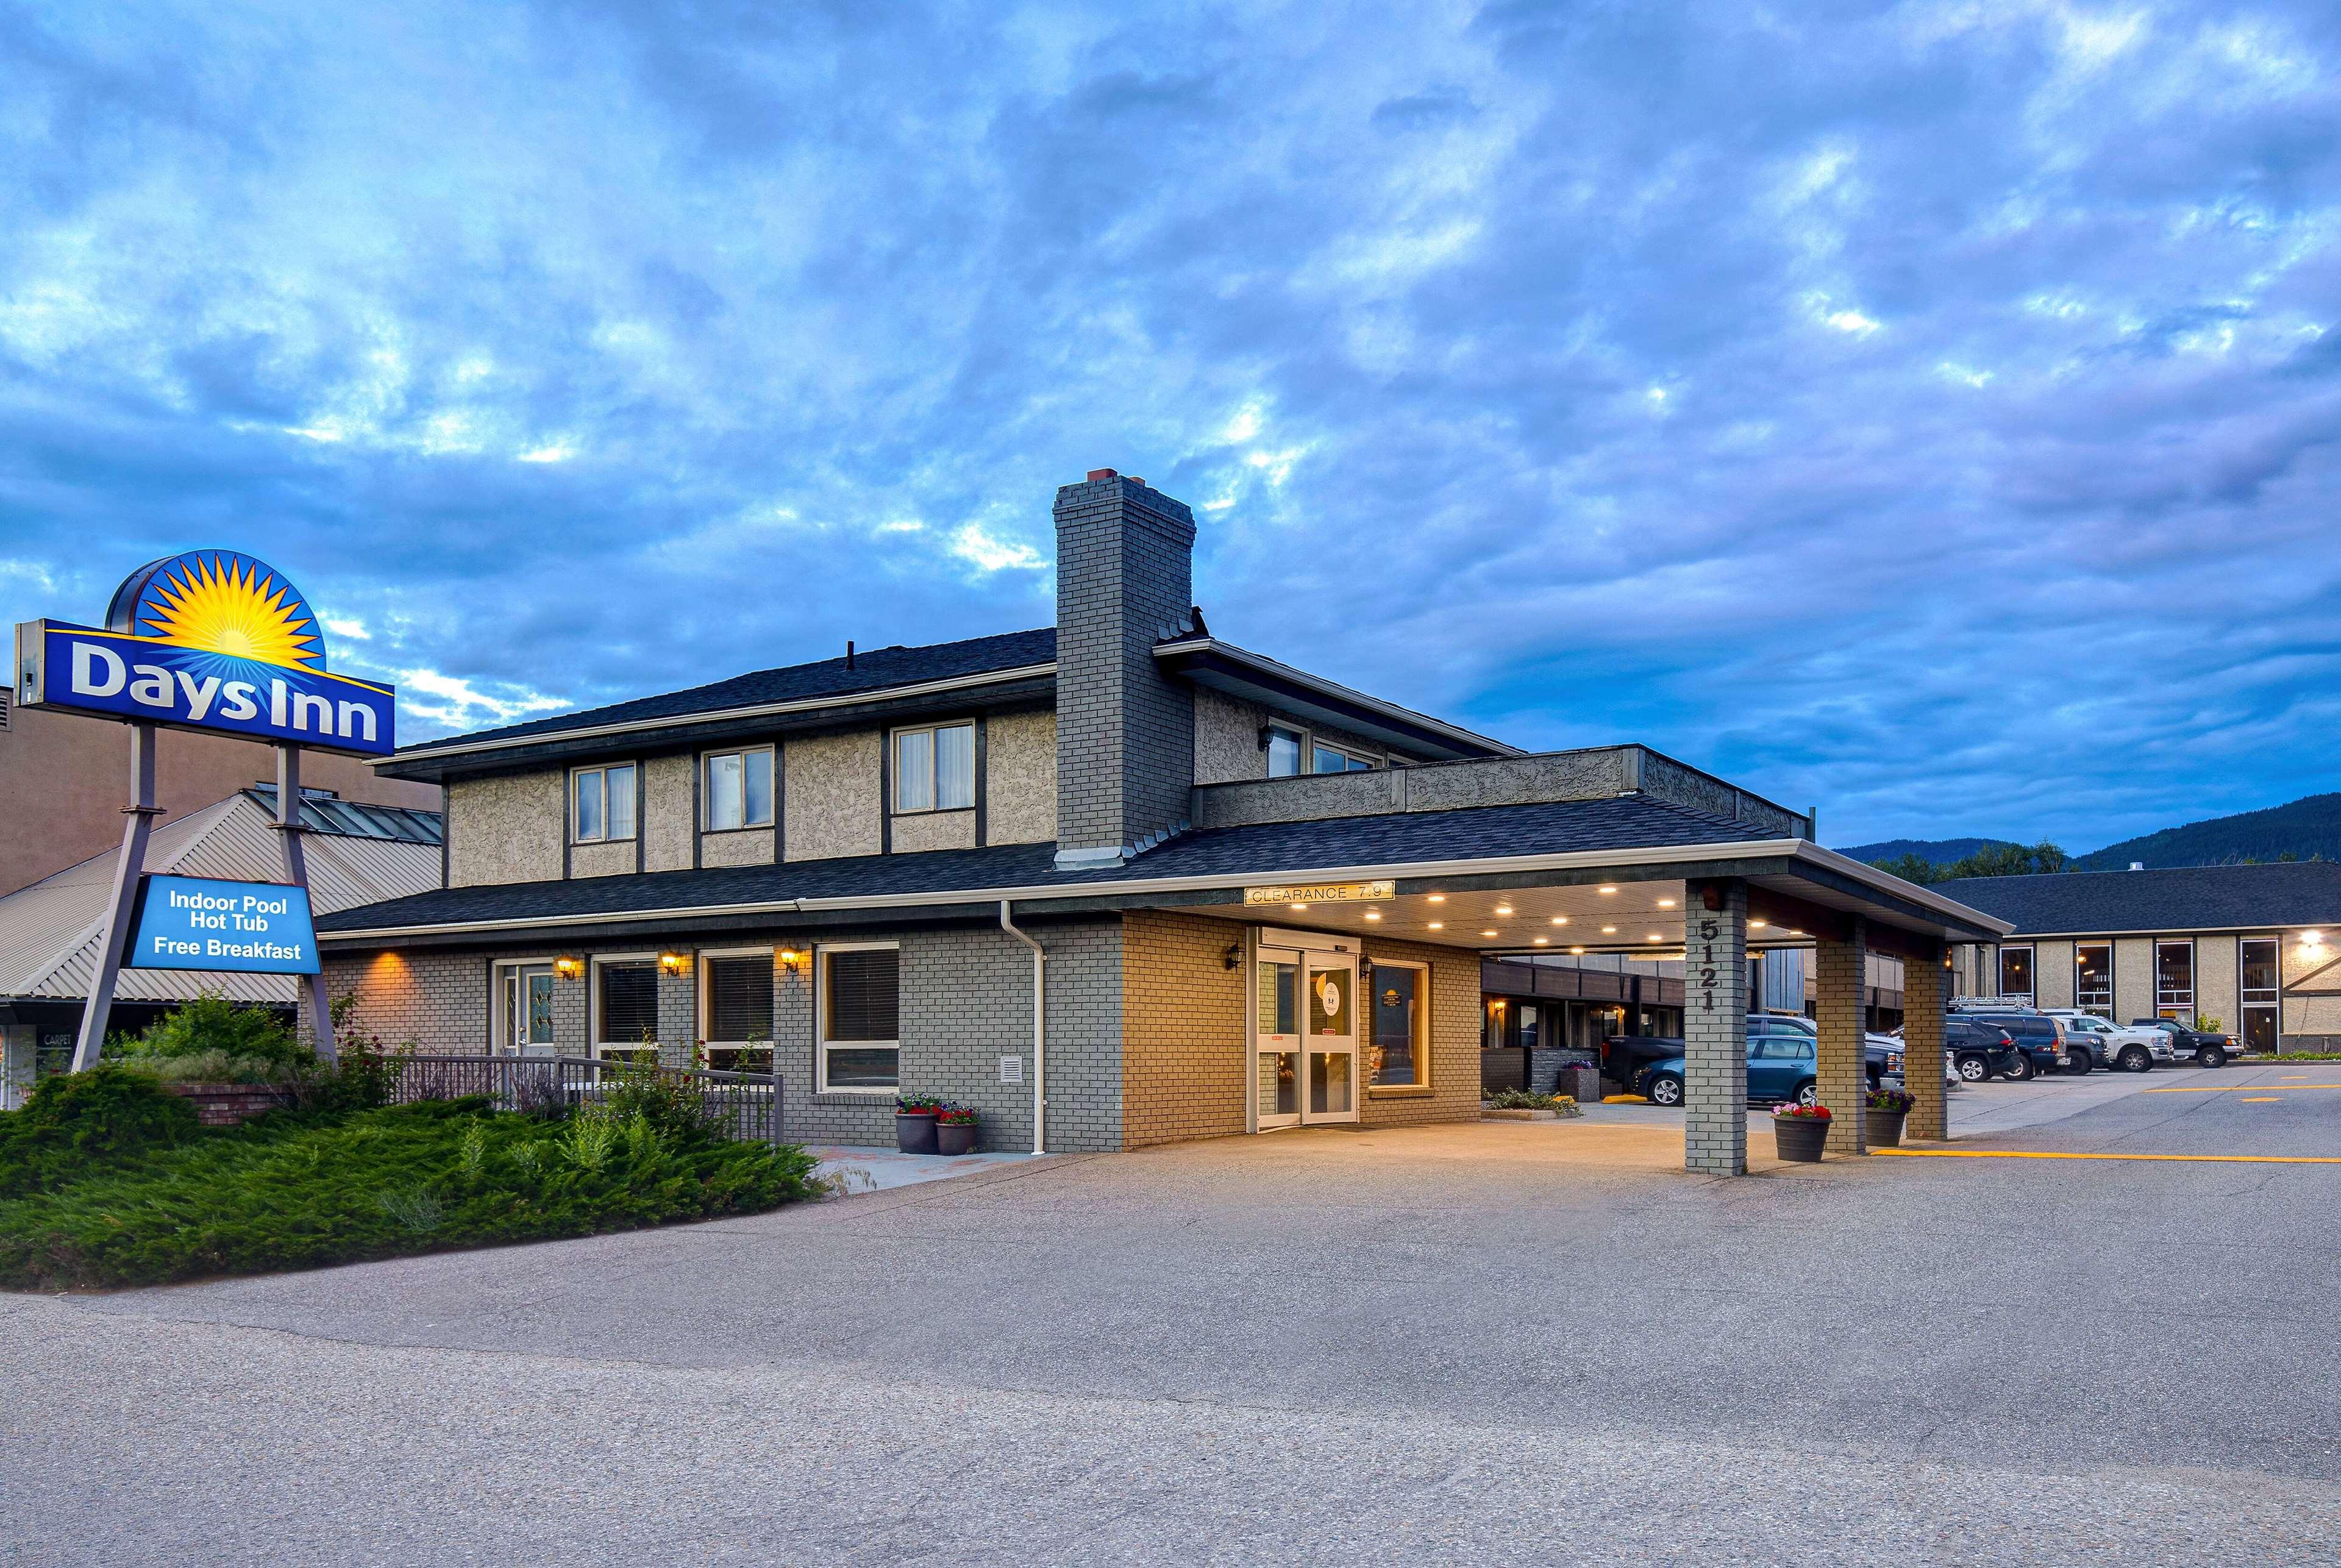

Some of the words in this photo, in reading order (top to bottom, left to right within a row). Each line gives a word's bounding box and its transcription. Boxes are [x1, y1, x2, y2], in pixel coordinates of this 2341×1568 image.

[72, 641, 257, 721] Days
[271, 679, 377, 741] Inn
[170, 890, 238, 911] Indoor
[244, 896, 287, 914] Pool
[1252, 888, 1347, 902] CLEARANCE
[1358, 886, 1382, 897] 7.9
[191, 911, 226, 930] Hot
[232, 913, 268, 932] Tub
[154, 936, 201, 955] Free
[207, 939, 301, 960] Breakfast
[1700, 919, 1719, 1010] 5121
[44, 1034, 71, 1046] CARPET
